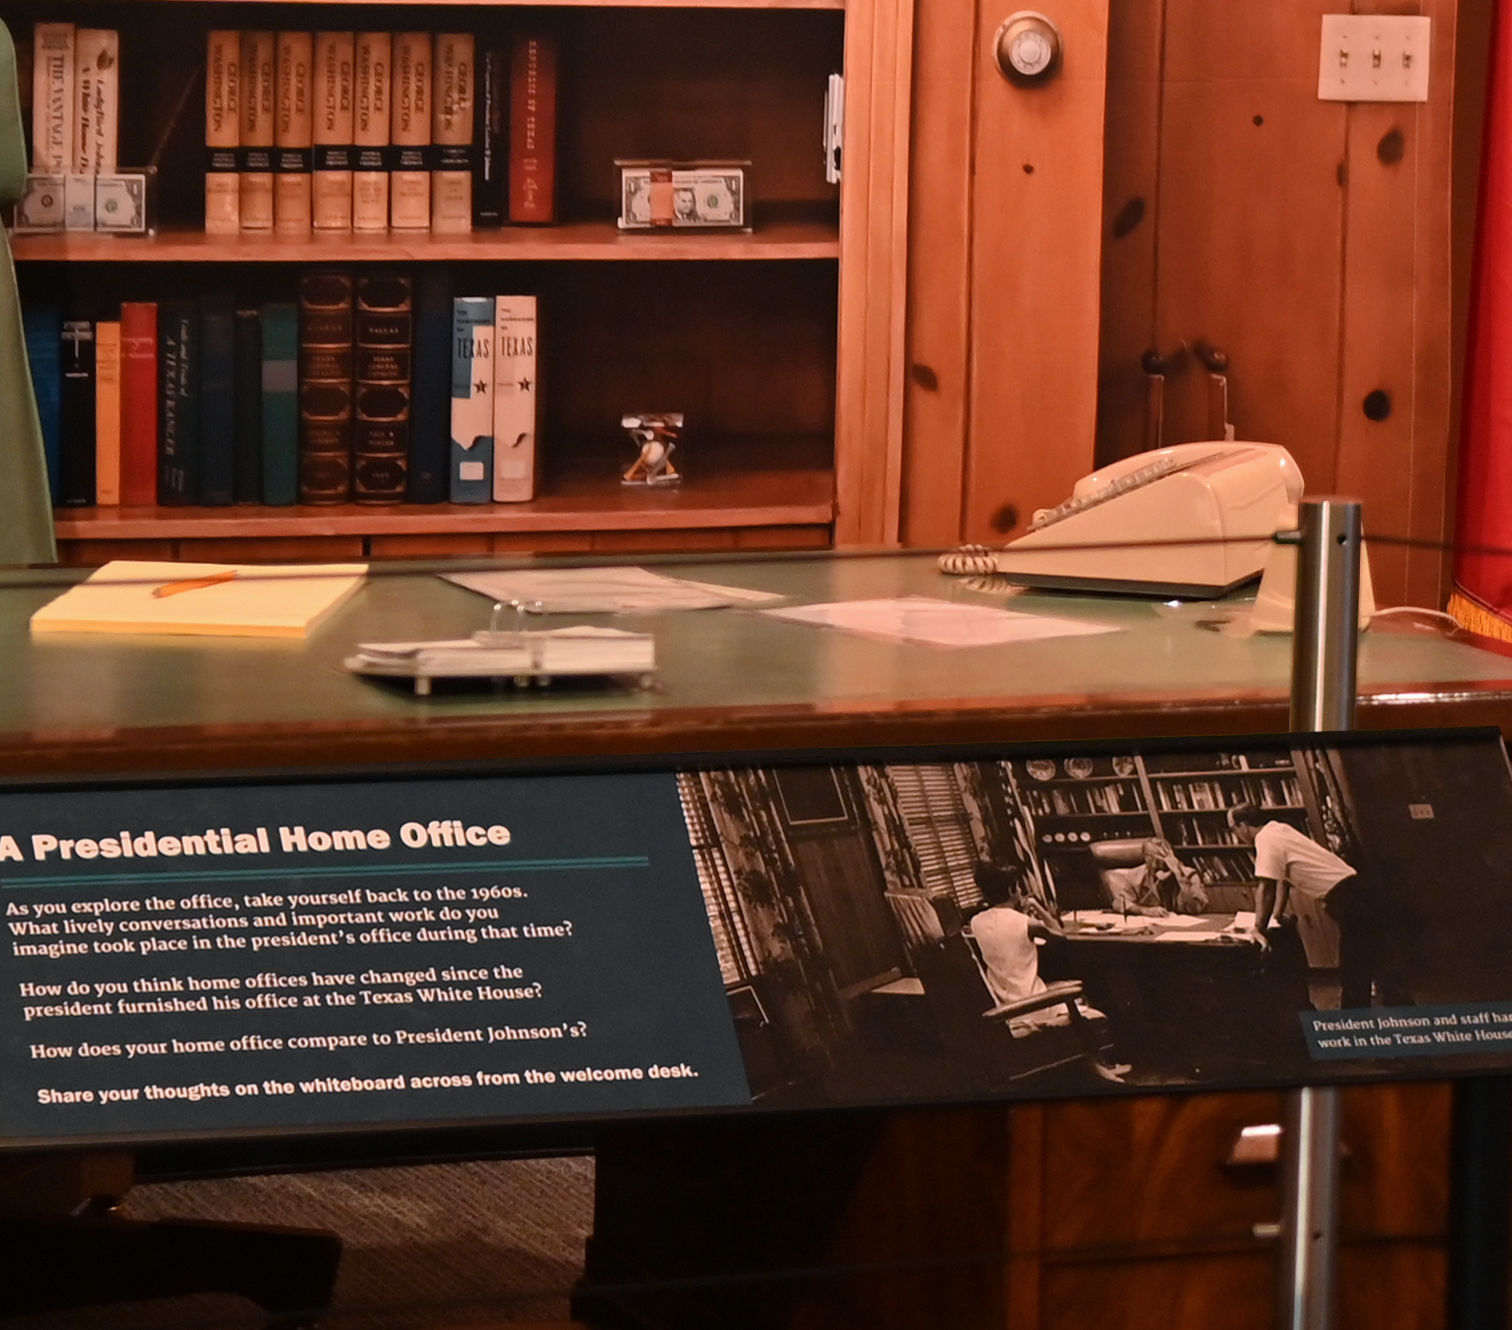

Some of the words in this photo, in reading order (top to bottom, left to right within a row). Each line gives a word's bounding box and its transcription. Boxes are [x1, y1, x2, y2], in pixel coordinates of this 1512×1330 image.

[456, 337, 489, 359] TEXAS
[501, 336, 534, 357] TEXAS
[30, 826, 270, 861] Presidential
[277, 825, 391, 852] Home
[398, 819, 511, 848] Office
[5, 901, 29, 916] As
[31, 902, 67, 918] you
[70, 897, 140, 916] explore
[144, 895, 176, 911] the
[179, 893, 240, 911] office,
[242, 892, 284, 907] take
[286, 887, 362, 909] yourself
[364, 887, 409, 903] back
[412, 888, 432, 902] to
[435, 885, 466, 901] the
[469, 884, 528, 901] 1960s.
[7, 920, 59, 936] What
[62, 917, 114, 936] lively
[118, 913, 249, 932] conversations
[252, 911, 287, 927] and
[290, 910, 385, 929] important
[387, 906, 436, 922] work
[438, 905, 462, 921] do
[464, 907, 499, 923] you
[11, 939, 88, 959] imagine
[92, 937, 136, 953] took
[138, 936, 188, 955] place
[191, 934, 212, 950] in
[215, 933, 246, 949] the
[358, 927, 412, 944] office
[415, 925, 478, 944] during
[479, 924, 519, 939] that
[521, 919, 572, 938] time?
[18, 981, 62, 997] How
[65, 980, 90, 995] do
[93, 981, 128, 998] you
[131, 976, 184, 993] think
[186, 975, 241, 991] home
[243, 971, 308, 988] offices
[310, 970, 355, 986] have
[359, 966, 437, 987] changed
[440, 965, 489, 981] since
[492, 964, 523, 979] the
[22, 1000, 113, 1021] president
[116, 995, 208, 1014] furnished
[210, 994, 241, 1010] his
[244, 992, 298, 1009] office
[302, 993, 321, 1007] at
[324, 990, 356, 1006] the
[358, 989, 414, 1005] Texas
[415, 985, 473, 1002] White
[475, 981, 542, 1000] House?
[1311, 1017, 1375, 1032] President
[1376, 1015, 1431, 1030] Johnson
[1432, 1012, 1458, 1026] and
[1459, 1011, 1490, 1025] staff
[29, 1043, 73, 1059] How
[76, 1041, 122, 1057] does
[124, 1042, 167, 1059] your
[170, 1037, 225, 1053] home
[228, 1034, 283, 1051] office
[286, 1034, 367, 1051] compare
[371, 1032, 392, 1045] to
[394, 1027, 484, 1044] President
[1316, 1035, 1352, 1048] work
[1352, 1035, 1368, 1047] in
[1368, 1033, 1392, 1046] the
[1392, 1032, 1432, 1045] Texas
[1431, 1030, 1472, 1043] White
[36, 1088, 94, 1104] Share
[97, 1088, 140, 1105] your
[142, 1082, 231, 1101] thoughts
[233, 1082, 259, 1096] on
[261, 1079, 295, 1095] the
[297, 1073, 406, 1093] whiteboard
[409, 1074, 473, 1089] across
[475, 1070, 521, 1086] from
[523, 1068, 556, 1084] the
[559, 1066, 643, 1082] welcome
[646, 1062, 699, 1079] desk.
